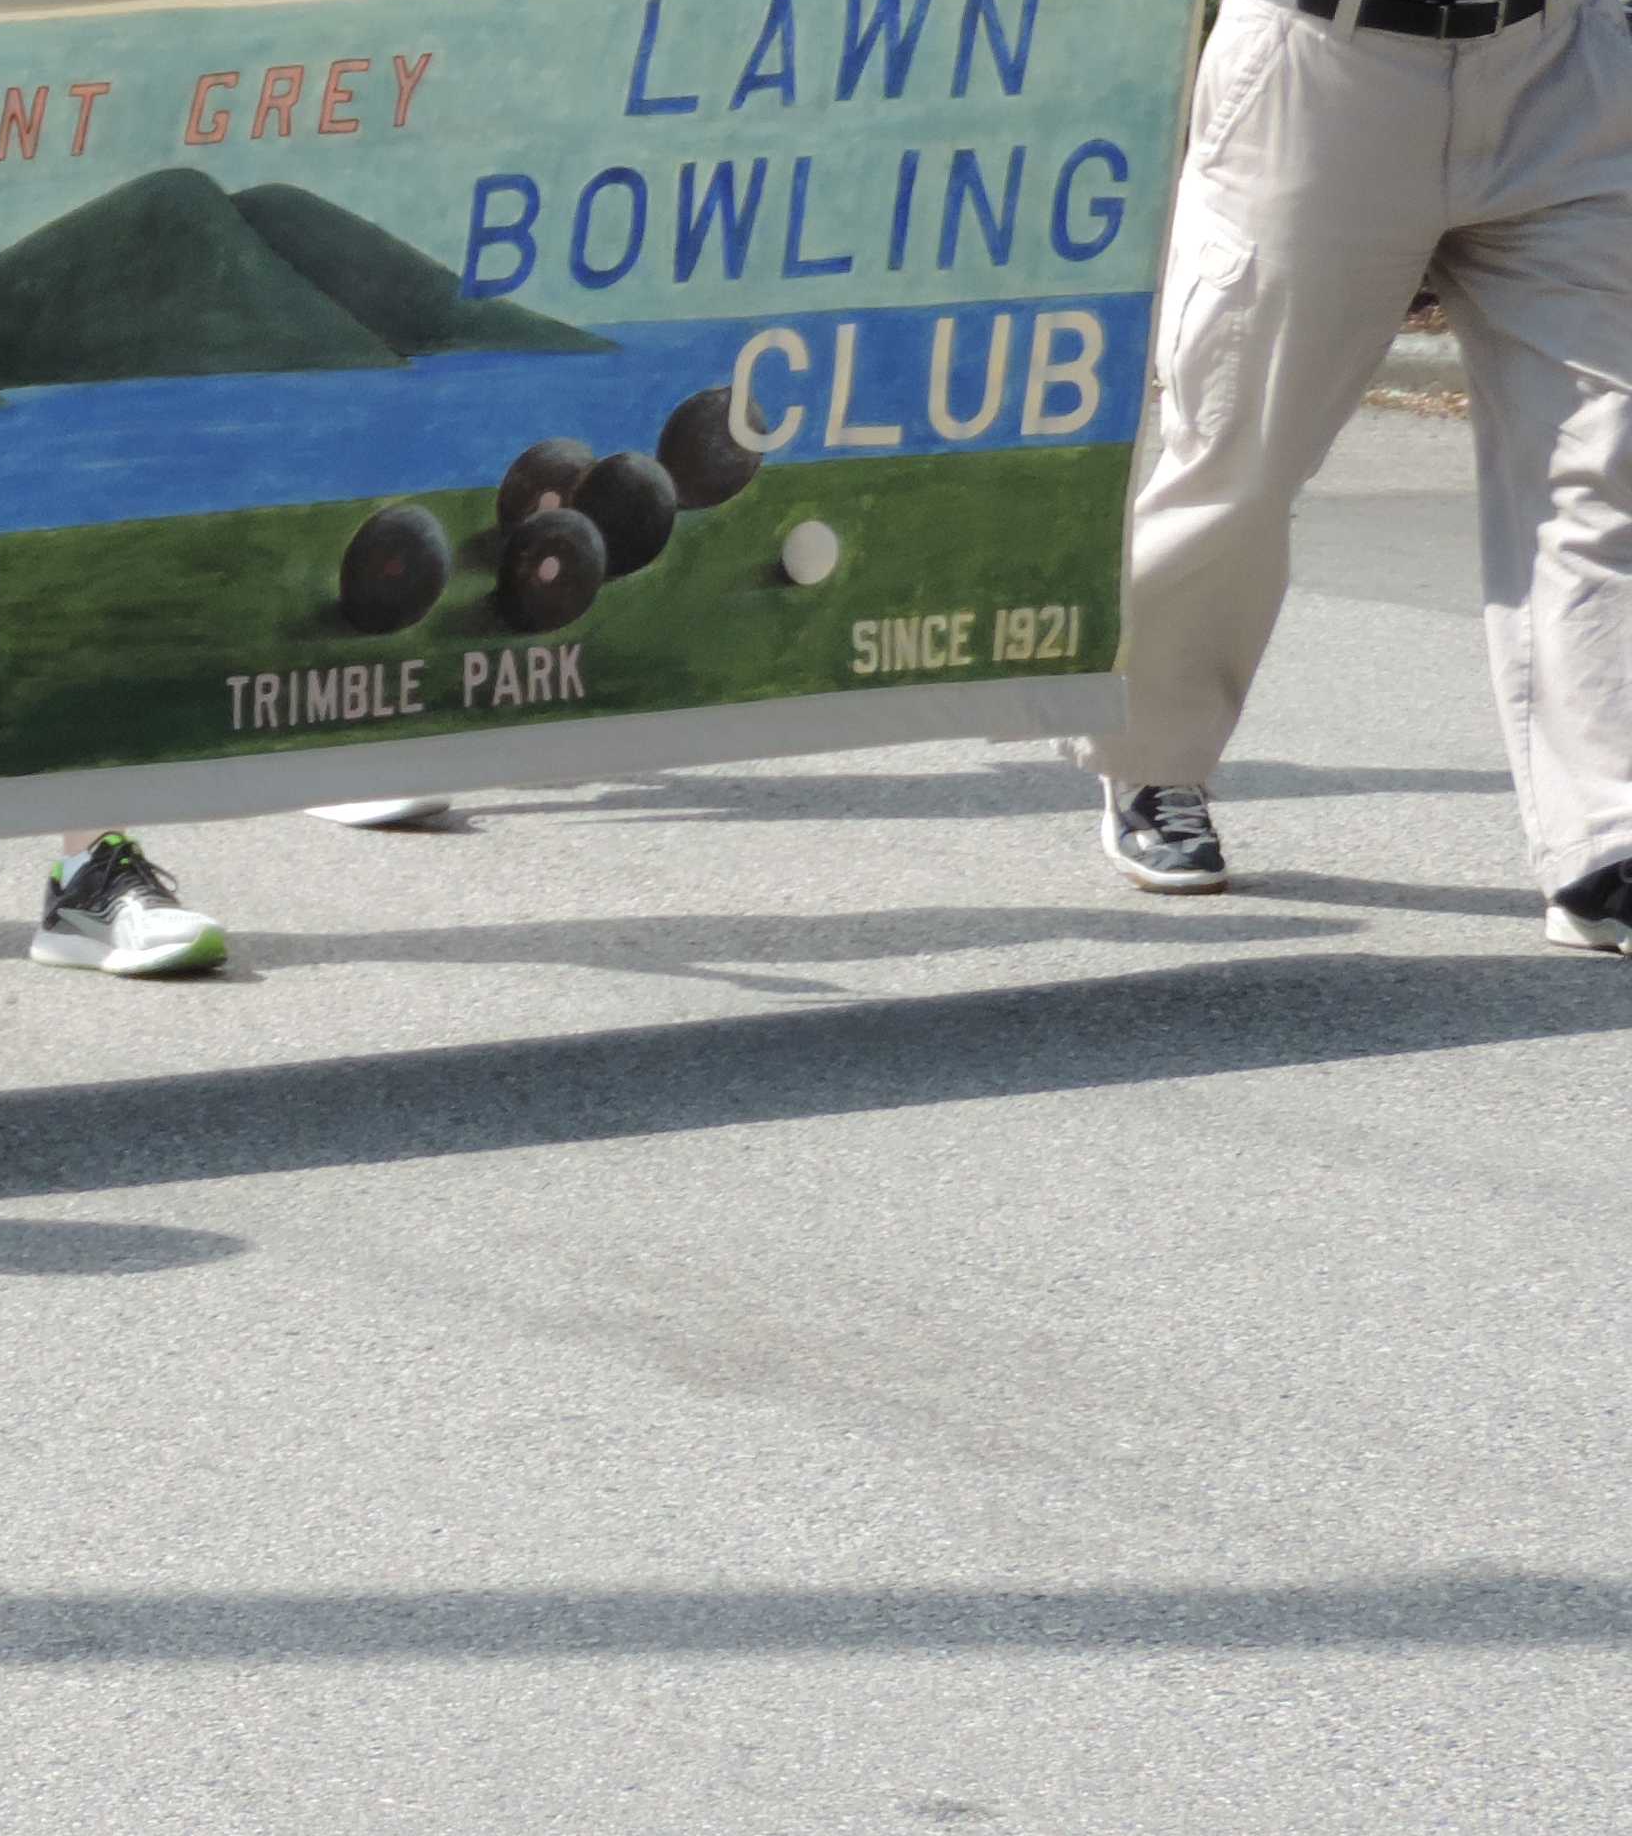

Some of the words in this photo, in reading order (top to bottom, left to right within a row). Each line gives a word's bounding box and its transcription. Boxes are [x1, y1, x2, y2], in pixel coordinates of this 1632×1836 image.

[183, 53, 433, 147] GREY
[459, 138, 1130, 300] BOWLING
[727, 309, 1105, 454] CLUB
[851, 611, 975, 676] SINCE
[991, 603, 1081, 663] 1921
[225, 658, 427, 731] TRIMBLE
[462, 643, 587, 709] PARK
